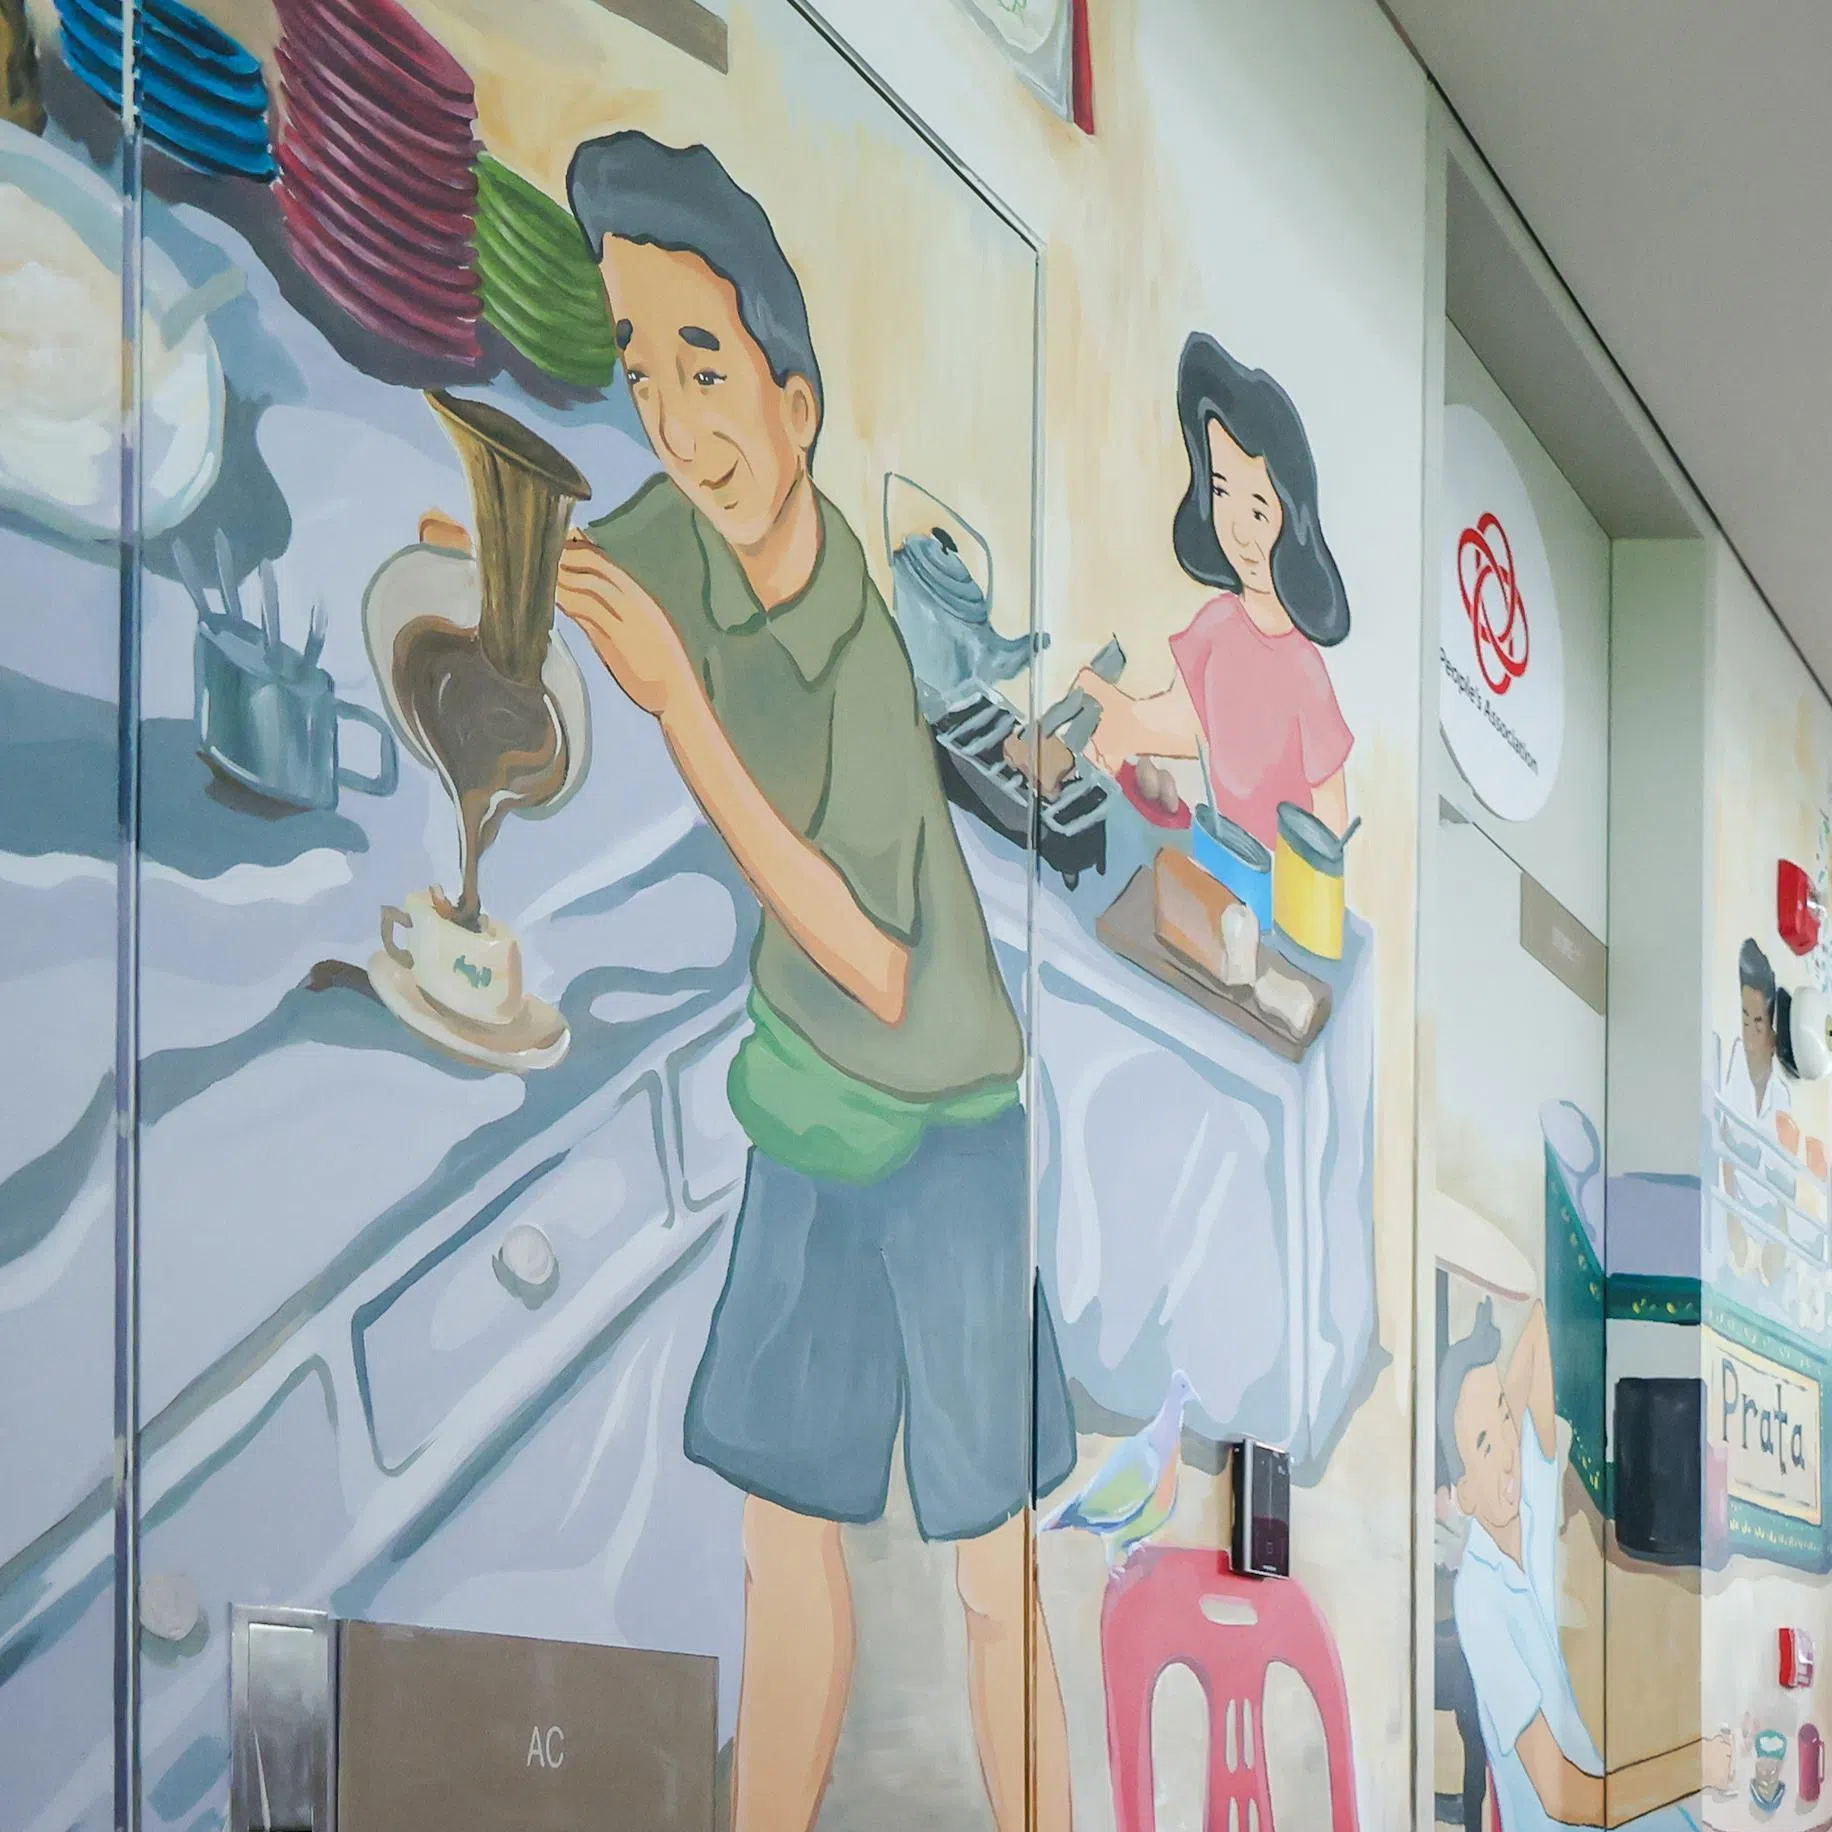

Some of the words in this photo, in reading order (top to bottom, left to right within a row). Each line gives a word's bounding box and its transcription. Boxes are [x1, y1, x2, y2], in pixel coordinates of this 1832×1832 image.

[1483, 699, 1538, 776] Association
[1721, 1358, 1806, 1476] Prata
[526, 1725, 565, 1769] AC
